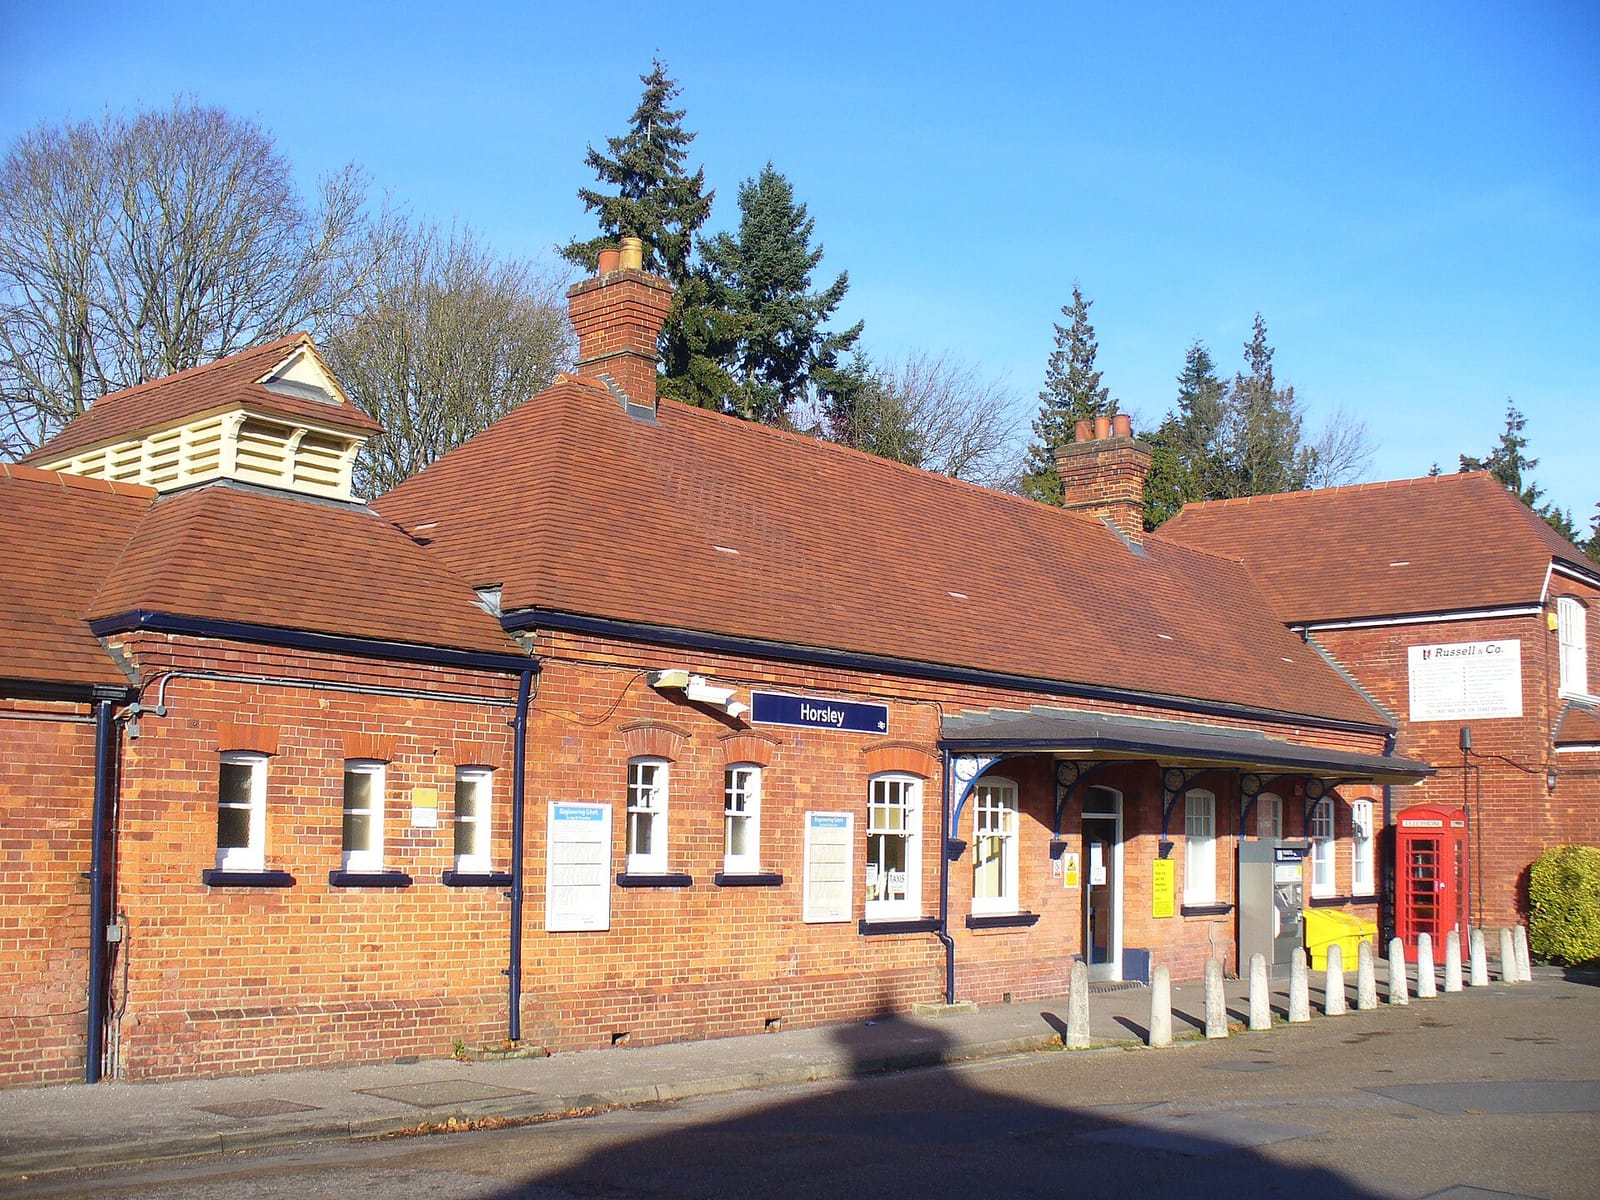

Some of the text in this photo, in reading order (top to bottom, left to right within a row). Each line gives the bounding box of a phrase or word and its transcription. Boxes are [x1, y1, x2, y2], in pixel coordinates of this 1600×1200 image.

[1435, 645, 1475, 657] Russell
[1485, 644, 1504, 654] Co.
[800, 703, 845, 727] Horsley
[889, 874, 905, 883] TAXIS
